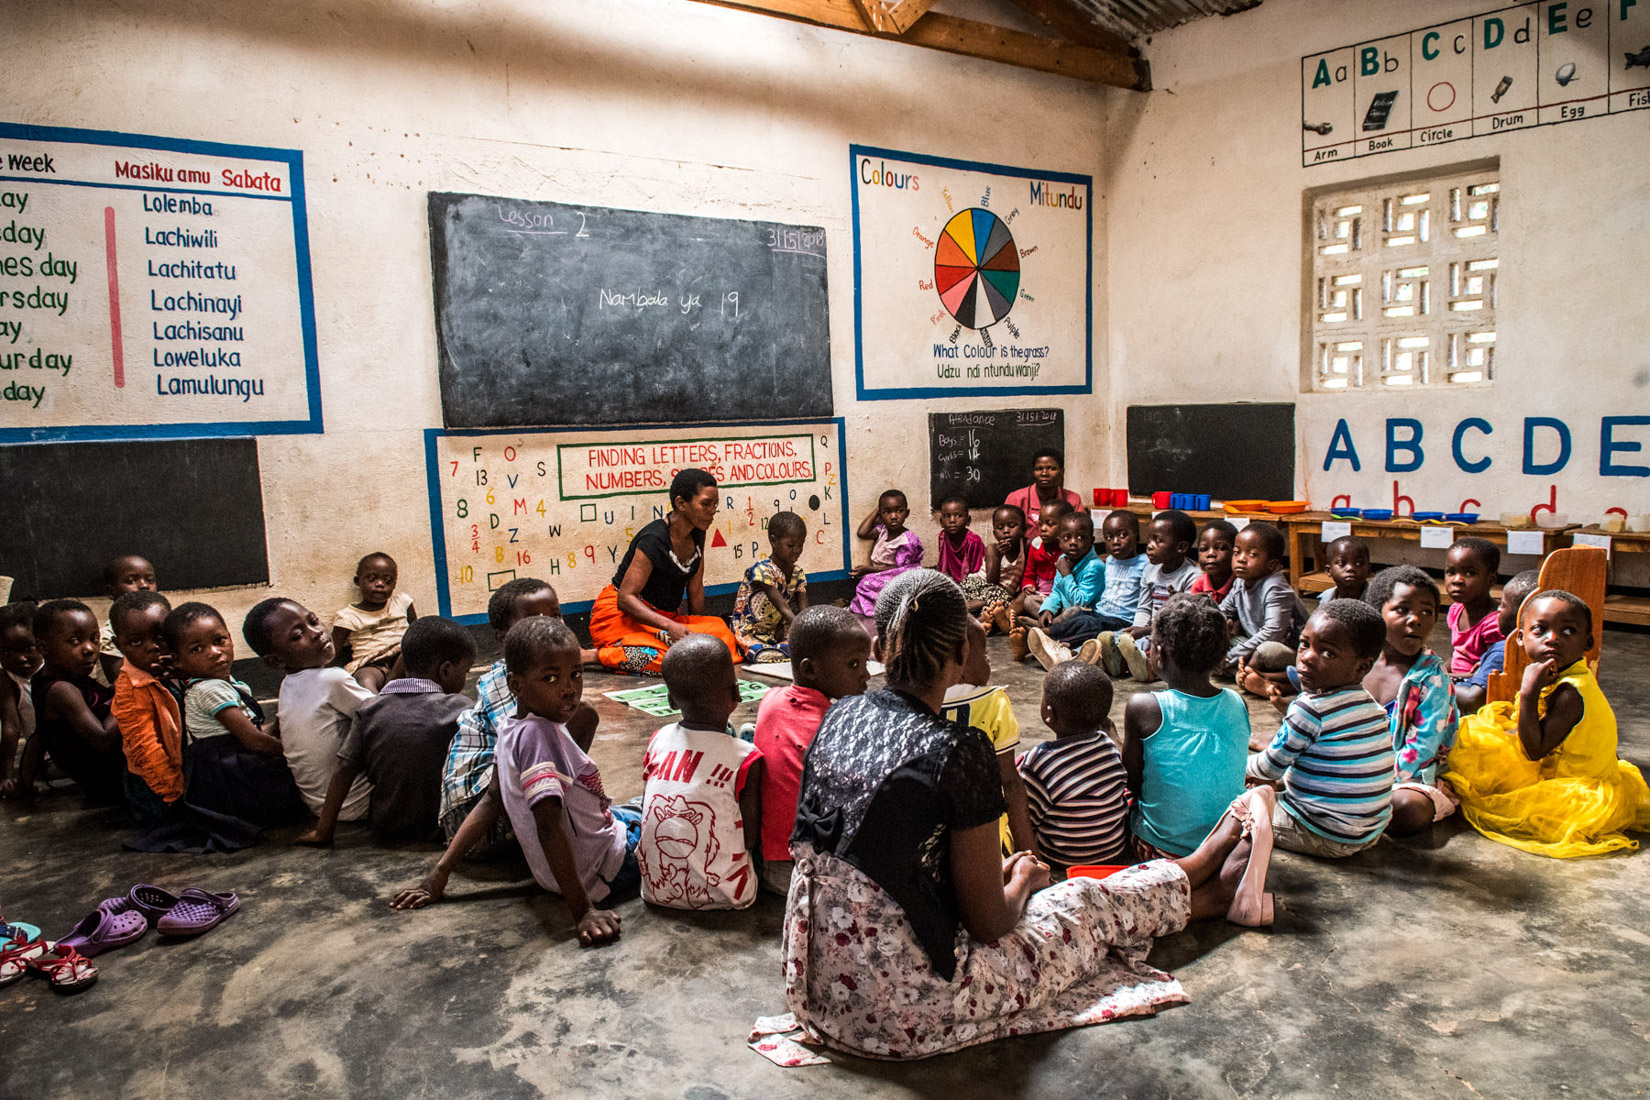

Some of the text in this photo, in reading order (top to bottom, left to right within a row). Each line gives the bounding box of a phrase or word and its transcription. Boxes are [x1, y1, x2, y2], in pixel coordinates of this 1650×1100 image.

[1561, 105, 1585, 119] Egg
[1492, 114, 1524, 130] Drum
[1369, 137, 1394, 151] Book
[1421, 128, 1453, 143] Circle
[1314, 148, 1338, 162] Arm
[115, 160, 282, 192] Masiku amu Sabata
[861, 158, 920, 191] Colours
[0, 192, 28, 214] ay
[980, 185, 991, 208] Blue
[1030, 180, 1083, 210] Mitundu
[143, 193, 213, 216] Lolemba
[498, 205, 590, 237] Lesson 2
[0, 220, 45, 250] day
[145, 226, 218, 248] Lachiwili
[912, 226, 935, 250] Orange
[1019, 245, 1039, 259] Brown
[148, 259, 236, 280] Lachitatu
[919, 279, 934, 291] Red
[0, 285, 68, 316] rsday
[599, 286, 739, 317] Nambala ya 19
[1019, 288, 1035, 303] Green
[151, 289, 242, 320] Lachinayi
[930, 309, 946, 326] Pink
[153, 320, 244, 341] Lachisanu
[154, 347, 241, 367] Loweluka
[933, 344, 959, 359] What
[963, 344, 997, 359] Colour
[1000, 344, 1008, 358] is
[1024, 346, 1050, 363] grass?
[937, 364, 961, 379] Udzu
[967, 364, 980, 378] ndi
[984, 363, 1014, 378] ntundu
[0, 380, 45, 409] day
[157, 374, 264, 402] Lamulungu
[968, 429, 981, 448] 16
[1323, 415, 1650, 477] A B C D E
[473, 447, 482, 462] F
[588, 441, 798, 467] FINDING LETTERS, FRACTIONS,
[450, 461, 459, 477] 7
[476, 469, 488, 486] 13
[537, 461, 546, 477] S
[586, 469, 667, 490] NUMBERS,
[730, 464, 755, 481] AND
[825, 462, 832, 476] P
[507, 474, 519, 489] V
[486, 487, 495, 505] 6
[824, 486, 832, 501] K
[457, 499, 469, 519] 8
[514, 498, 527, 516] M
[536, 499, 547, 518] 4
[726, 496, 734, 510] R
[490, 513, 500, 529] D
[604, 511, 614, 525] U
[653, 505, 663, 520] N
[824, 512, 831, 525] L
[549, 524, 561, 538] W
[816, 529, 825, 545] C
[495, 546, 504, 563] B
[517, 549, 531, 566] 16
[607, 545, 618, 563] Y
[733, 544, 743, 559] 15
[752, 541, 759, 558] P
[550, 558, 561, 575] H
[568, 552, 577, 569] 8
